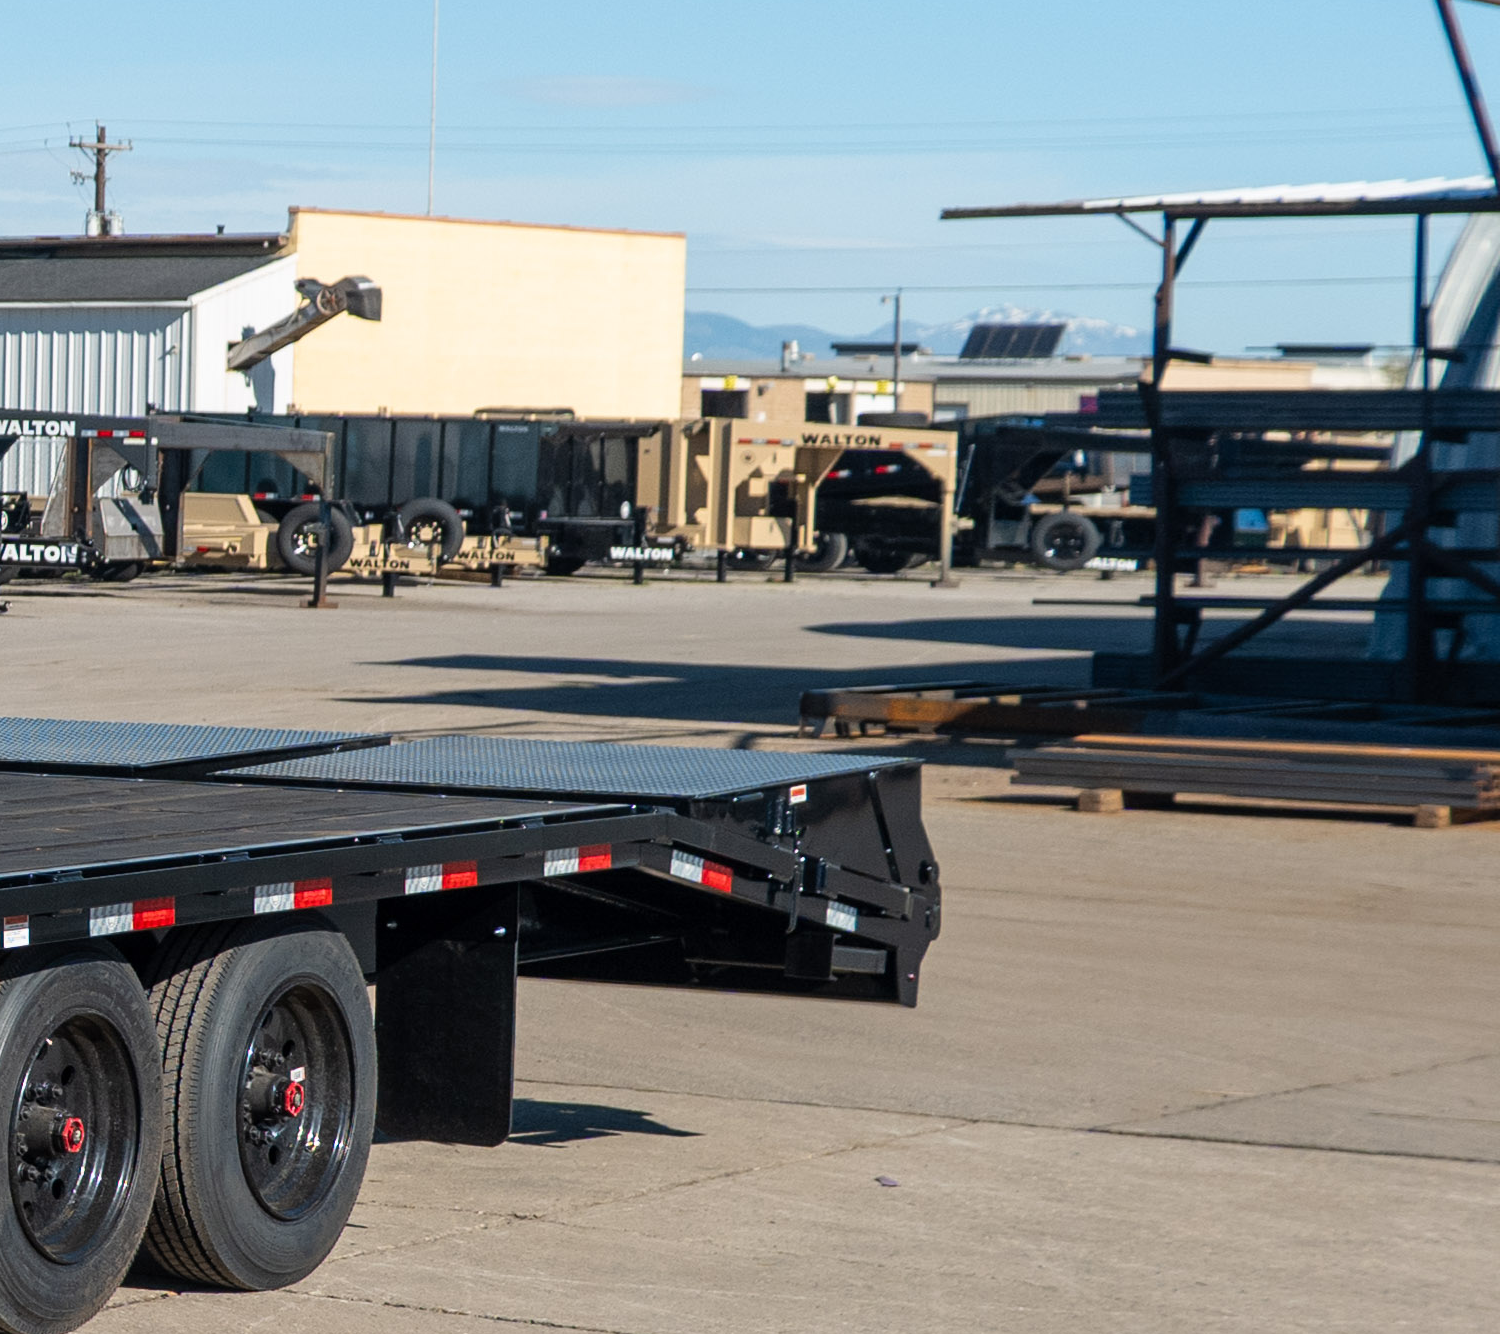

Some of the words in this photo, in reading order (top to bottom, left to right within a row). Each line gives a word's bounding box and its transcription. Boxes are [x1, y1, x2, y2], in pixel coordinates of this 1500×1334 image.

[801, 433, 882, 447] WALTON
[0, 543, 78, 563] ALTON
[457, 550, 516, 561] WALTON
[610, 546, 674, 561] WALTON
[350, 558, 410, 570] WALTON
